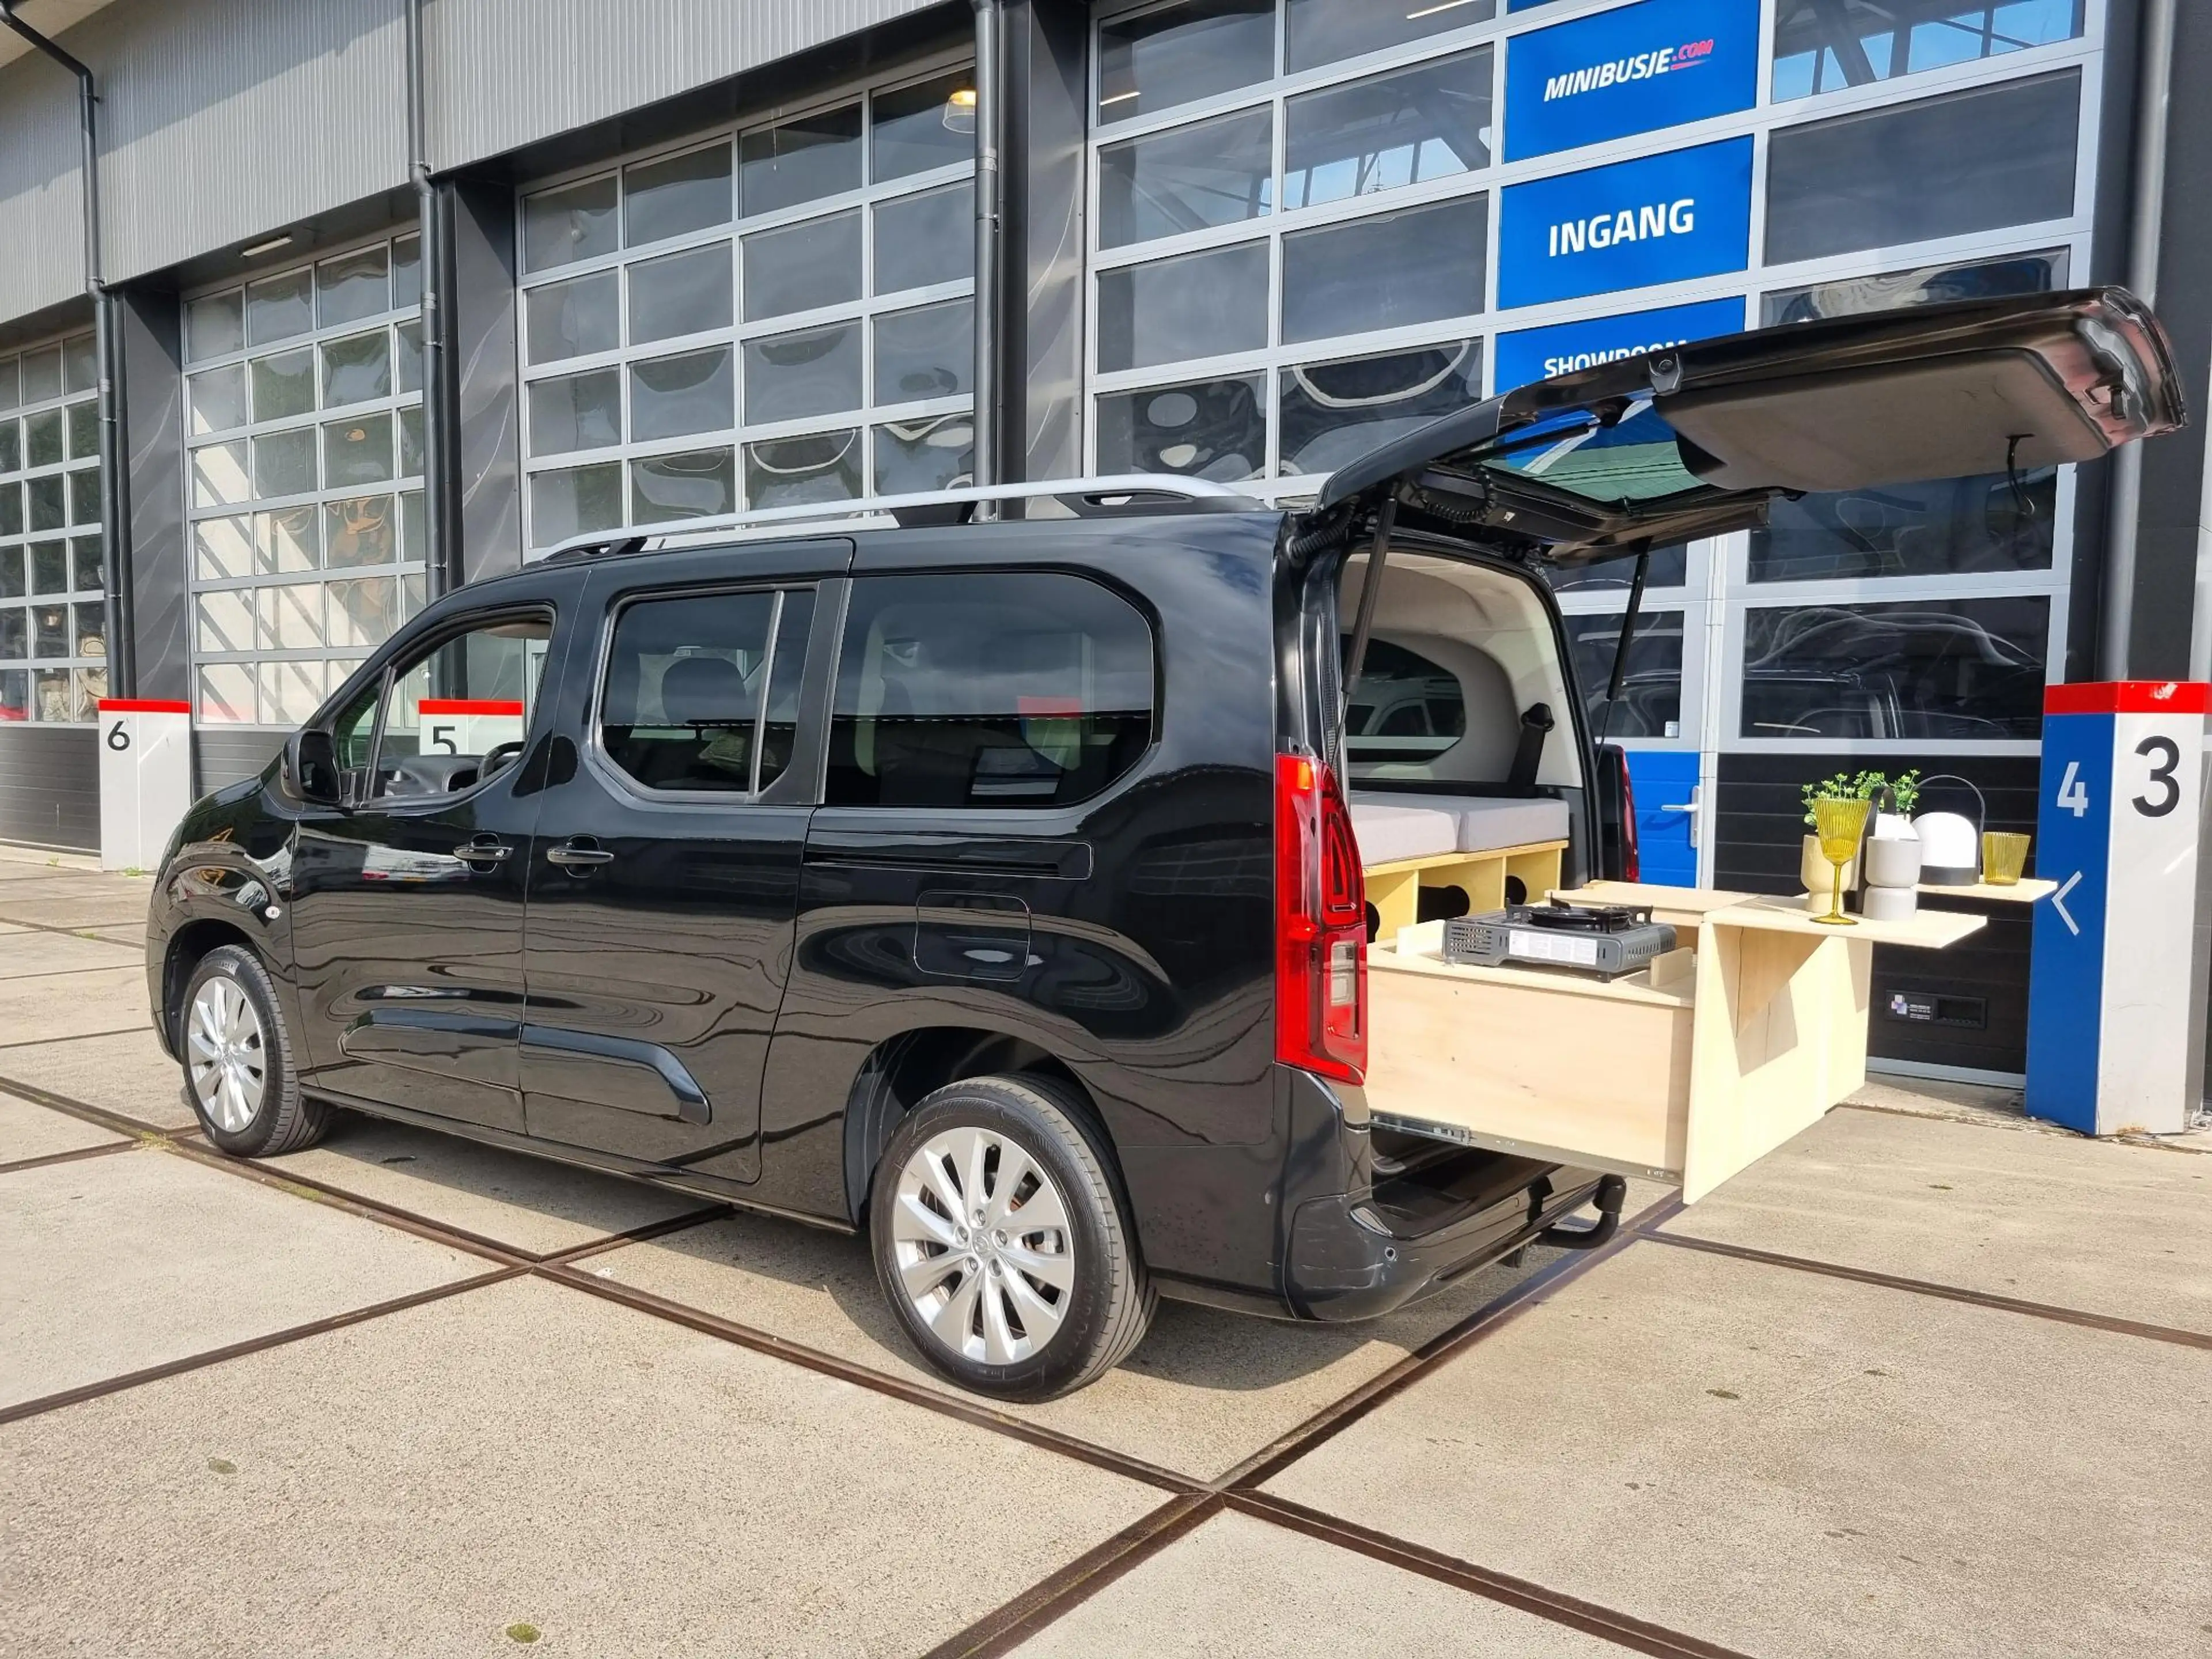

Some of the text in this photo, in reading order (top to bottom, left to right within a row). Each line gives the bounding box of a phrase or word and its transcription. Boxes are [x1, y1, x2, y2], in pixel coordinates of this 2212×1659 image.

[1550, 199, 1694, 257] INGANG
[108, 721, 130, 751] 6
[433, 726, 457, 755] 5
[2057, 762, 2088, 817] 4
[2132, 735, 2180, 817] 3
